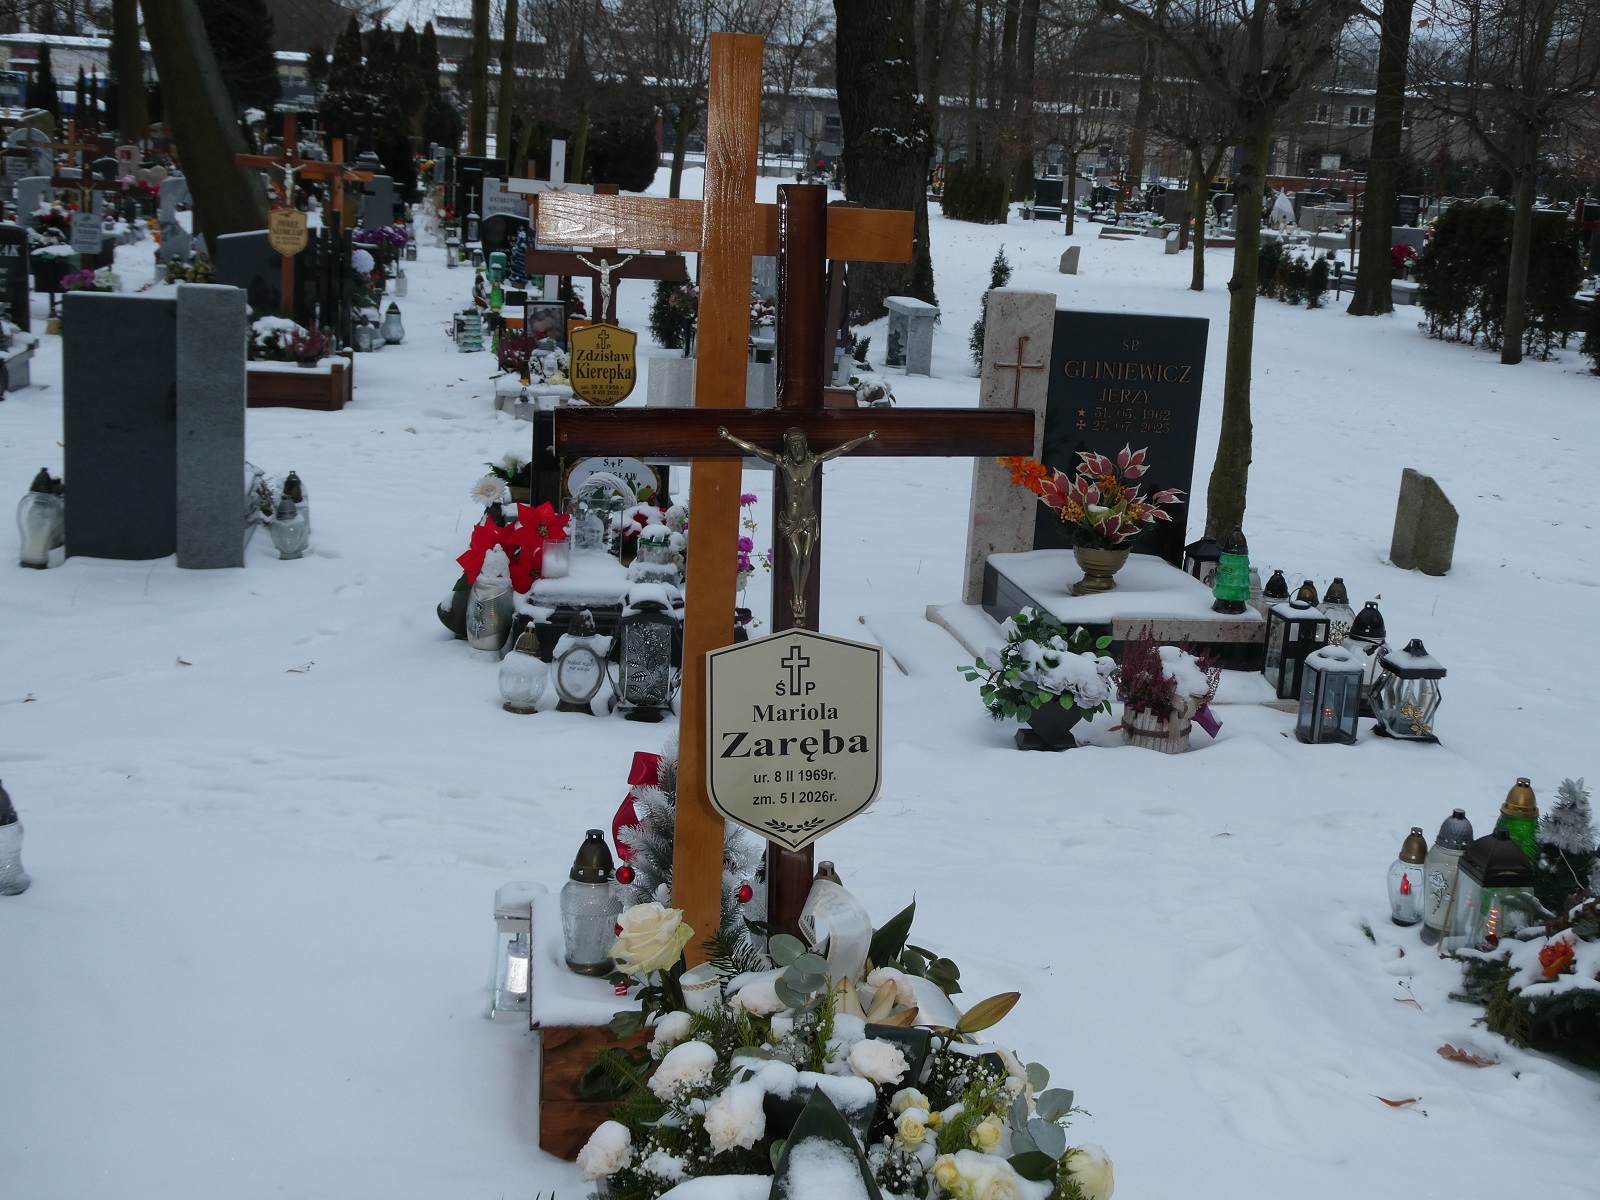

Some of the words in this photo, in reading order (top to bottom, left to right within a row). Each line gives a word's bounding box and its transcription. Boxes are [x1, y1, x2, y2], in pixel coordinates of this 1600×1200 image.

[576, 349, 631, 362] Zdzisław
[576, 363, 631, 383] Kierepka
[1064, 360, 1193, 383] GLINIEWICZ
[1099, 388, 1152, 404] JERZY
[1143, 409, 1171, 421] 1962
[1140, 422, 1170, 434] 2025
[775, 680, 786, 696] Ś
[806, 682, 816, 695] P
[752, 703, 839, 722] Mariola
[720, 729, 870, 762] Zaręba
[754, 773, 770, 783] ur.
[774, 771, 782, 782] 8
[798, 769, 836, 781] 1969r.
[753, 795, 775, 805] zm.
[780, 793, 787, 804] 5
[799, 791, 837, 803] 2026r.
